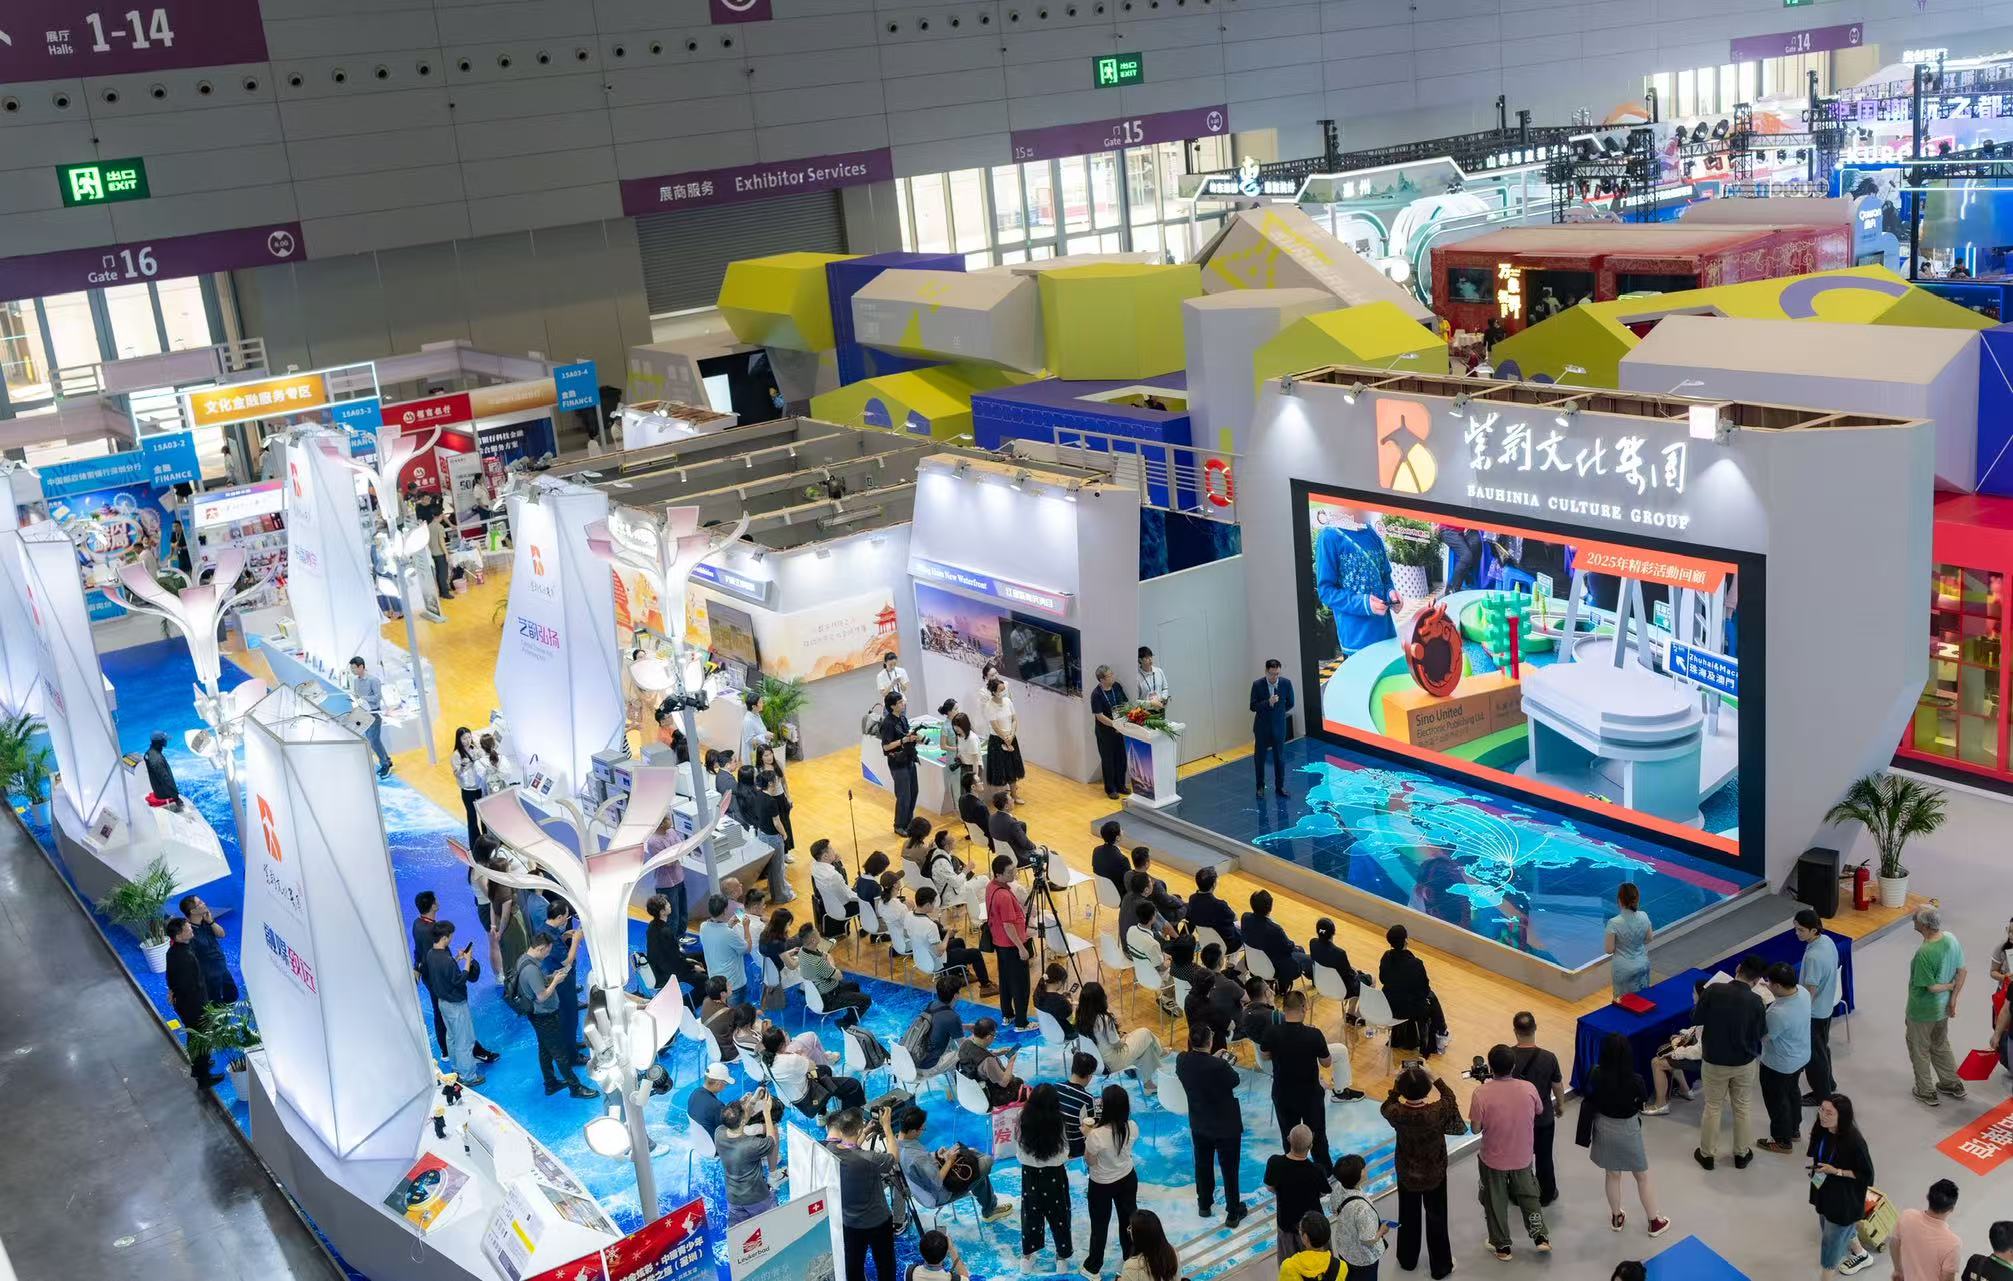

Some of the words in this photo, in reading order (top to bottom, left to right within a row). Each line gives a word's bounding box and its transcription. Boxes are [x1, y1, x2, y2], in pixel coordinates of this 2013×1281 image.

[46, 30, 70, 43] 展厅
[86, 8, 174, 52] 1-14
[48, 43, 74, 55] Halls
[1798, 32, 1811, 52] 14
[1120, 62, 1138, 70] 出口
[1120, 69, 1138, 78] EXIT
[1122, 120, 1144, 144] 15
[1104, 137, 1121, 147] Gate
[107, 170, 136, 181] 出口
[735, 172, 804, 192] Exhibitor
[808, 163, 867, 183] Services
[108, 180, 137, 192] EXIT
[660, 180, 714, 202] 展商服务
[103, 254, 116, 268] 门
[120, 247, 158, 279] 16
[88, 271, 118, 283] Gate
[204, 384, 313, 415] 文化金融服务专区
[562, 396, 593, 408] FINANCE
[480, 429, 524, 445] 银行科技金融
[155, 470, 193, 484] FINANCE
[1467, 485, 1540, 508] BAUHINIA
[1549, 496, 1623, 520] CULTURE
[1631, 508, 1690, 531] GROUP
[1586, 551, 1707, 585] 2025年精彩活動回顧
[1690, 663, 1735, 689] 珠海及澳門
[1416, 714, 1435, 727] Sino
[1436, 704, 1463, 722] United
